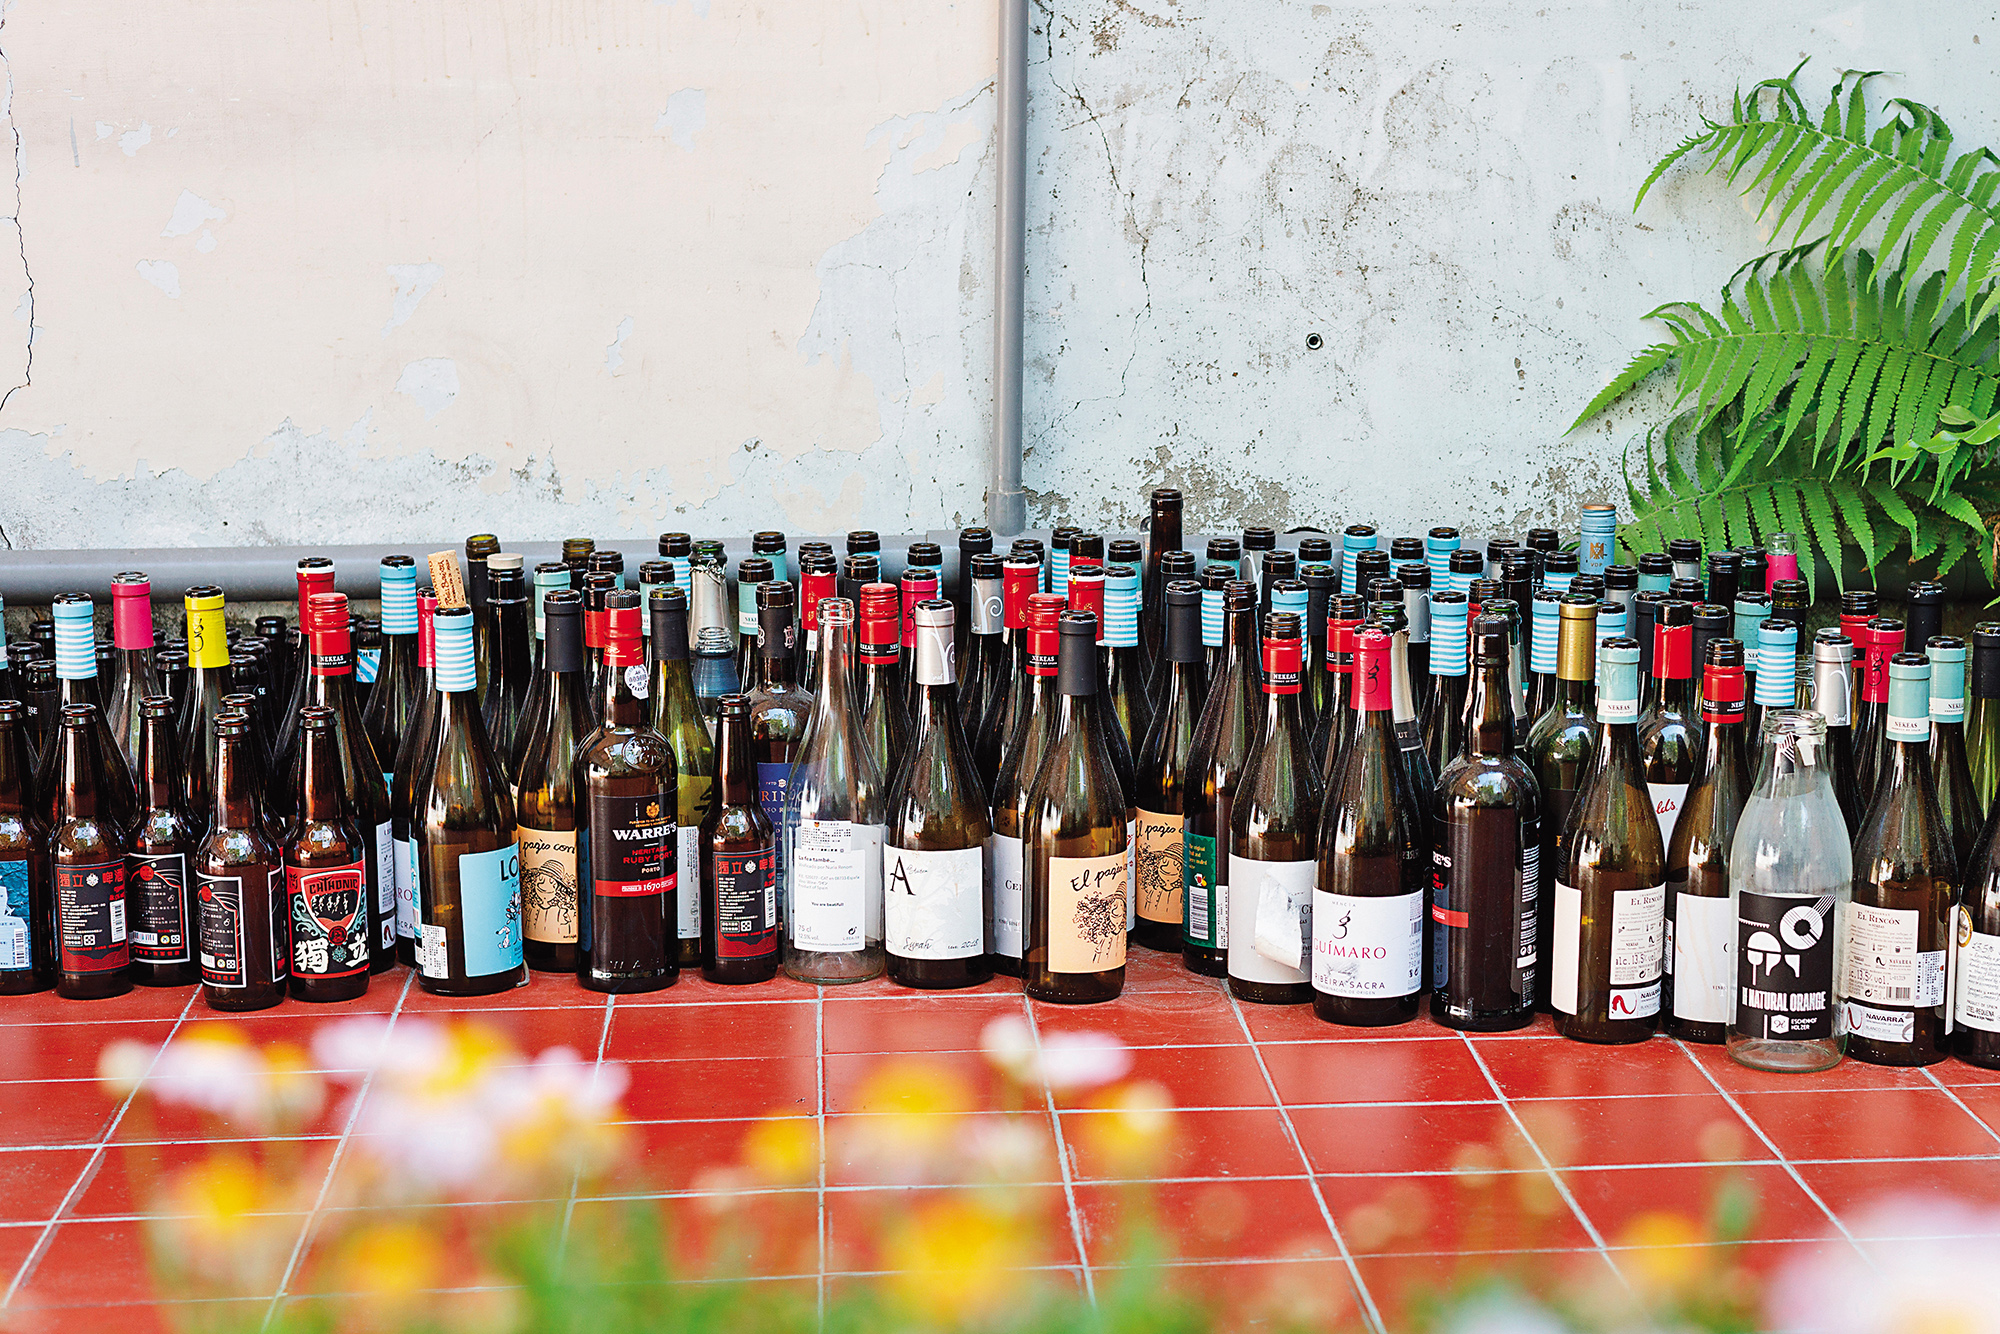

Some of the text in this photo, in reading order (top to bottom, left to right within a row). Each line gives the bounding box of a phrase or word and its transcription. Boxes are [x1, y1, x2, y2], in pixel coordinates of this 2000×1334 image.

[612, 821, 677, 841] WARRE'S
[623, 850, 673, 864] RUBY PORT
[632, 845, 668, 856] HERITAGE
[641, 866, 661, 874] PORTO
[890, 855, 917, 896] A
[309, 876, 358, 895] CHTHONIC
[643, 882, 661, 892] 1670
[1070, 869, 1091, 892] El
[1857, 911, 1901, 926] EL RINCÓN
[295, 931, 370, 974] 獨立
[1314, 938, 1387, 960] GUÍMARO
[1349, 980, 1385, 990] SACRA
[1748, 988, 1789, 1012] NATURAL
[1789, 990, 1826, 1012] ORANGE
[1866, 1012, 1905, 1023] NAVARRA
